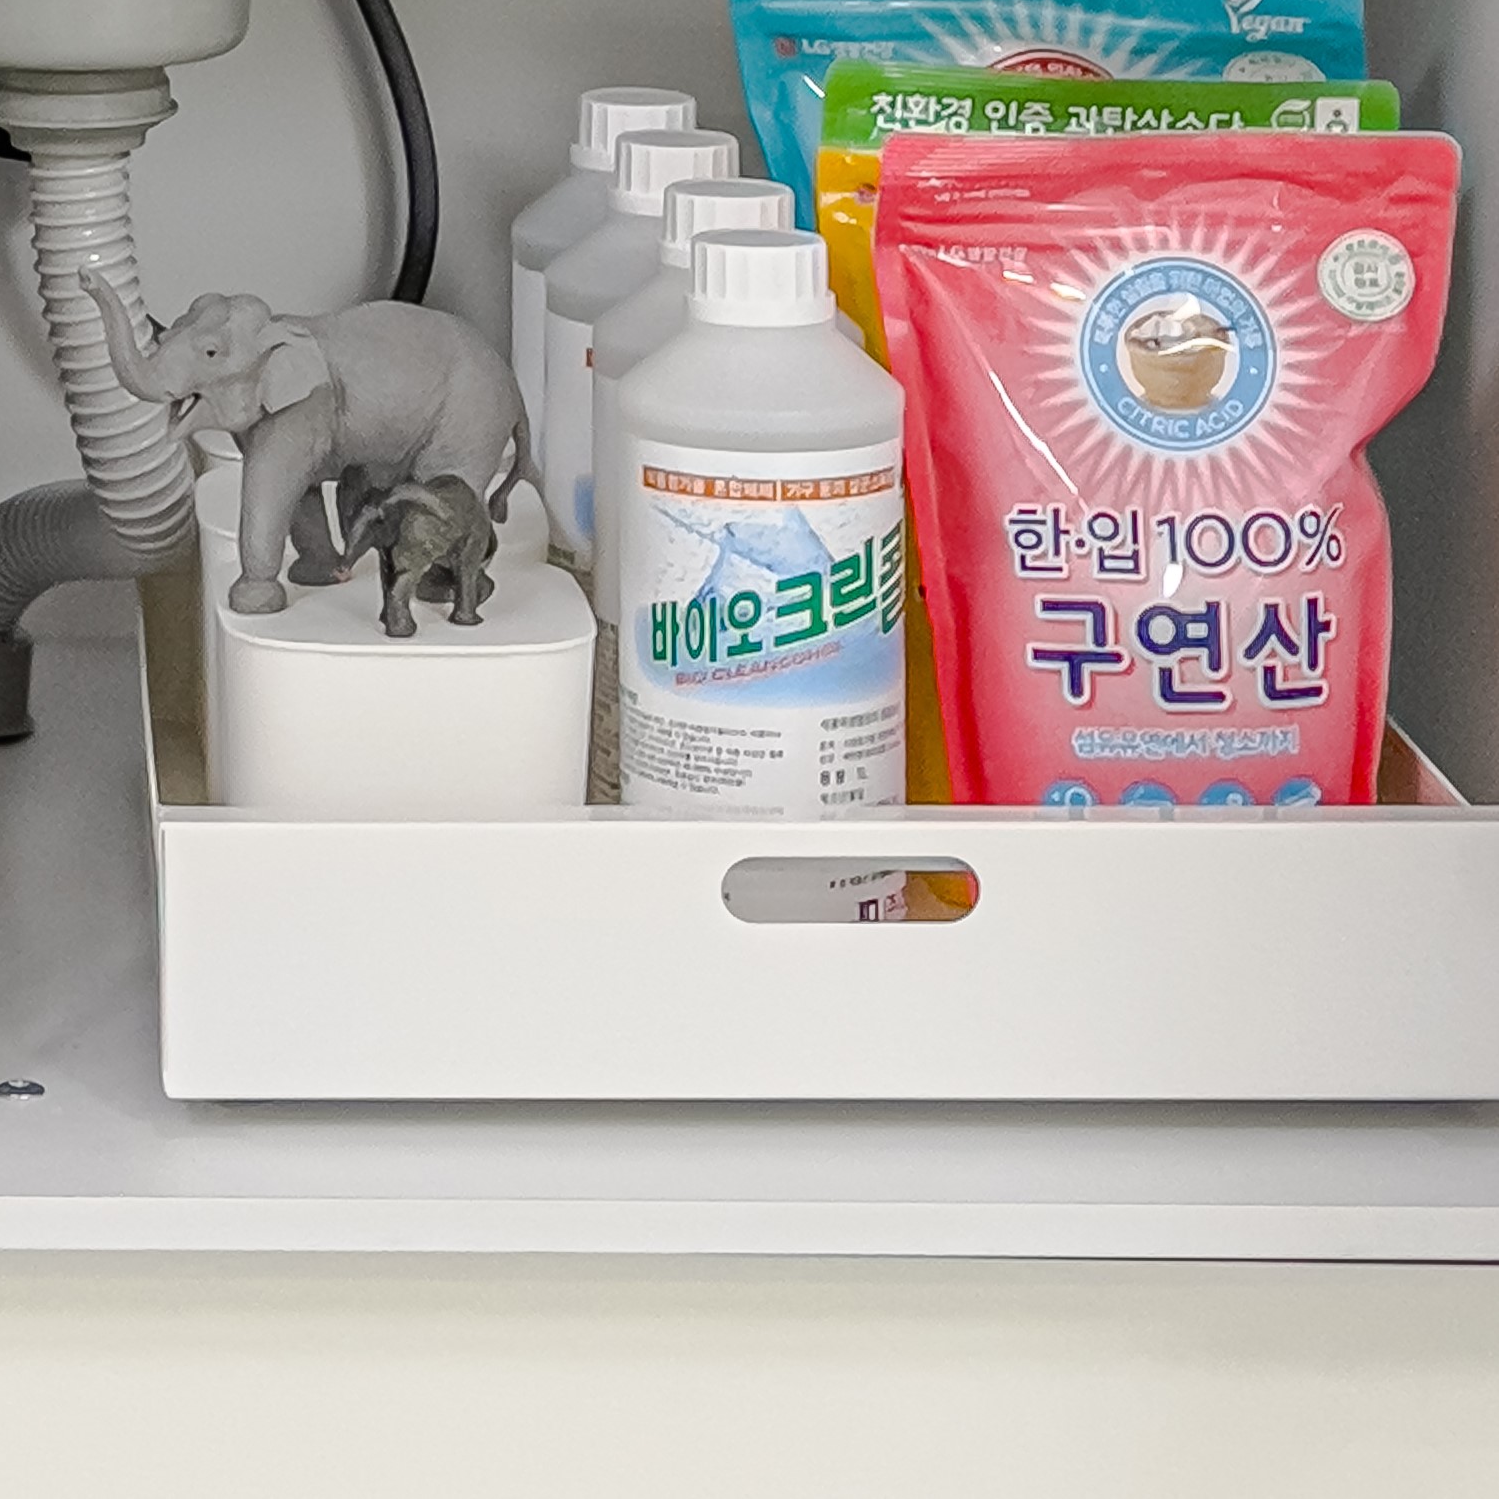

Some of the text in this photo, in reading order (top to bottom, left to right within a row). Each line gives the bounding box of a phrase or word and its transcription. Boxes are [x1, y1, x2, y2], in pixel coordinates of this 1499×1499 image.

[870, 92, 973, 134] 친환경
[984, 100, 1054, 135] 인증
[1117, 395, 1244, 438] CITRIC ACID
[1156, 503, 1344, 568] 100%
[1031, 597, 1337, 705] 구연산
